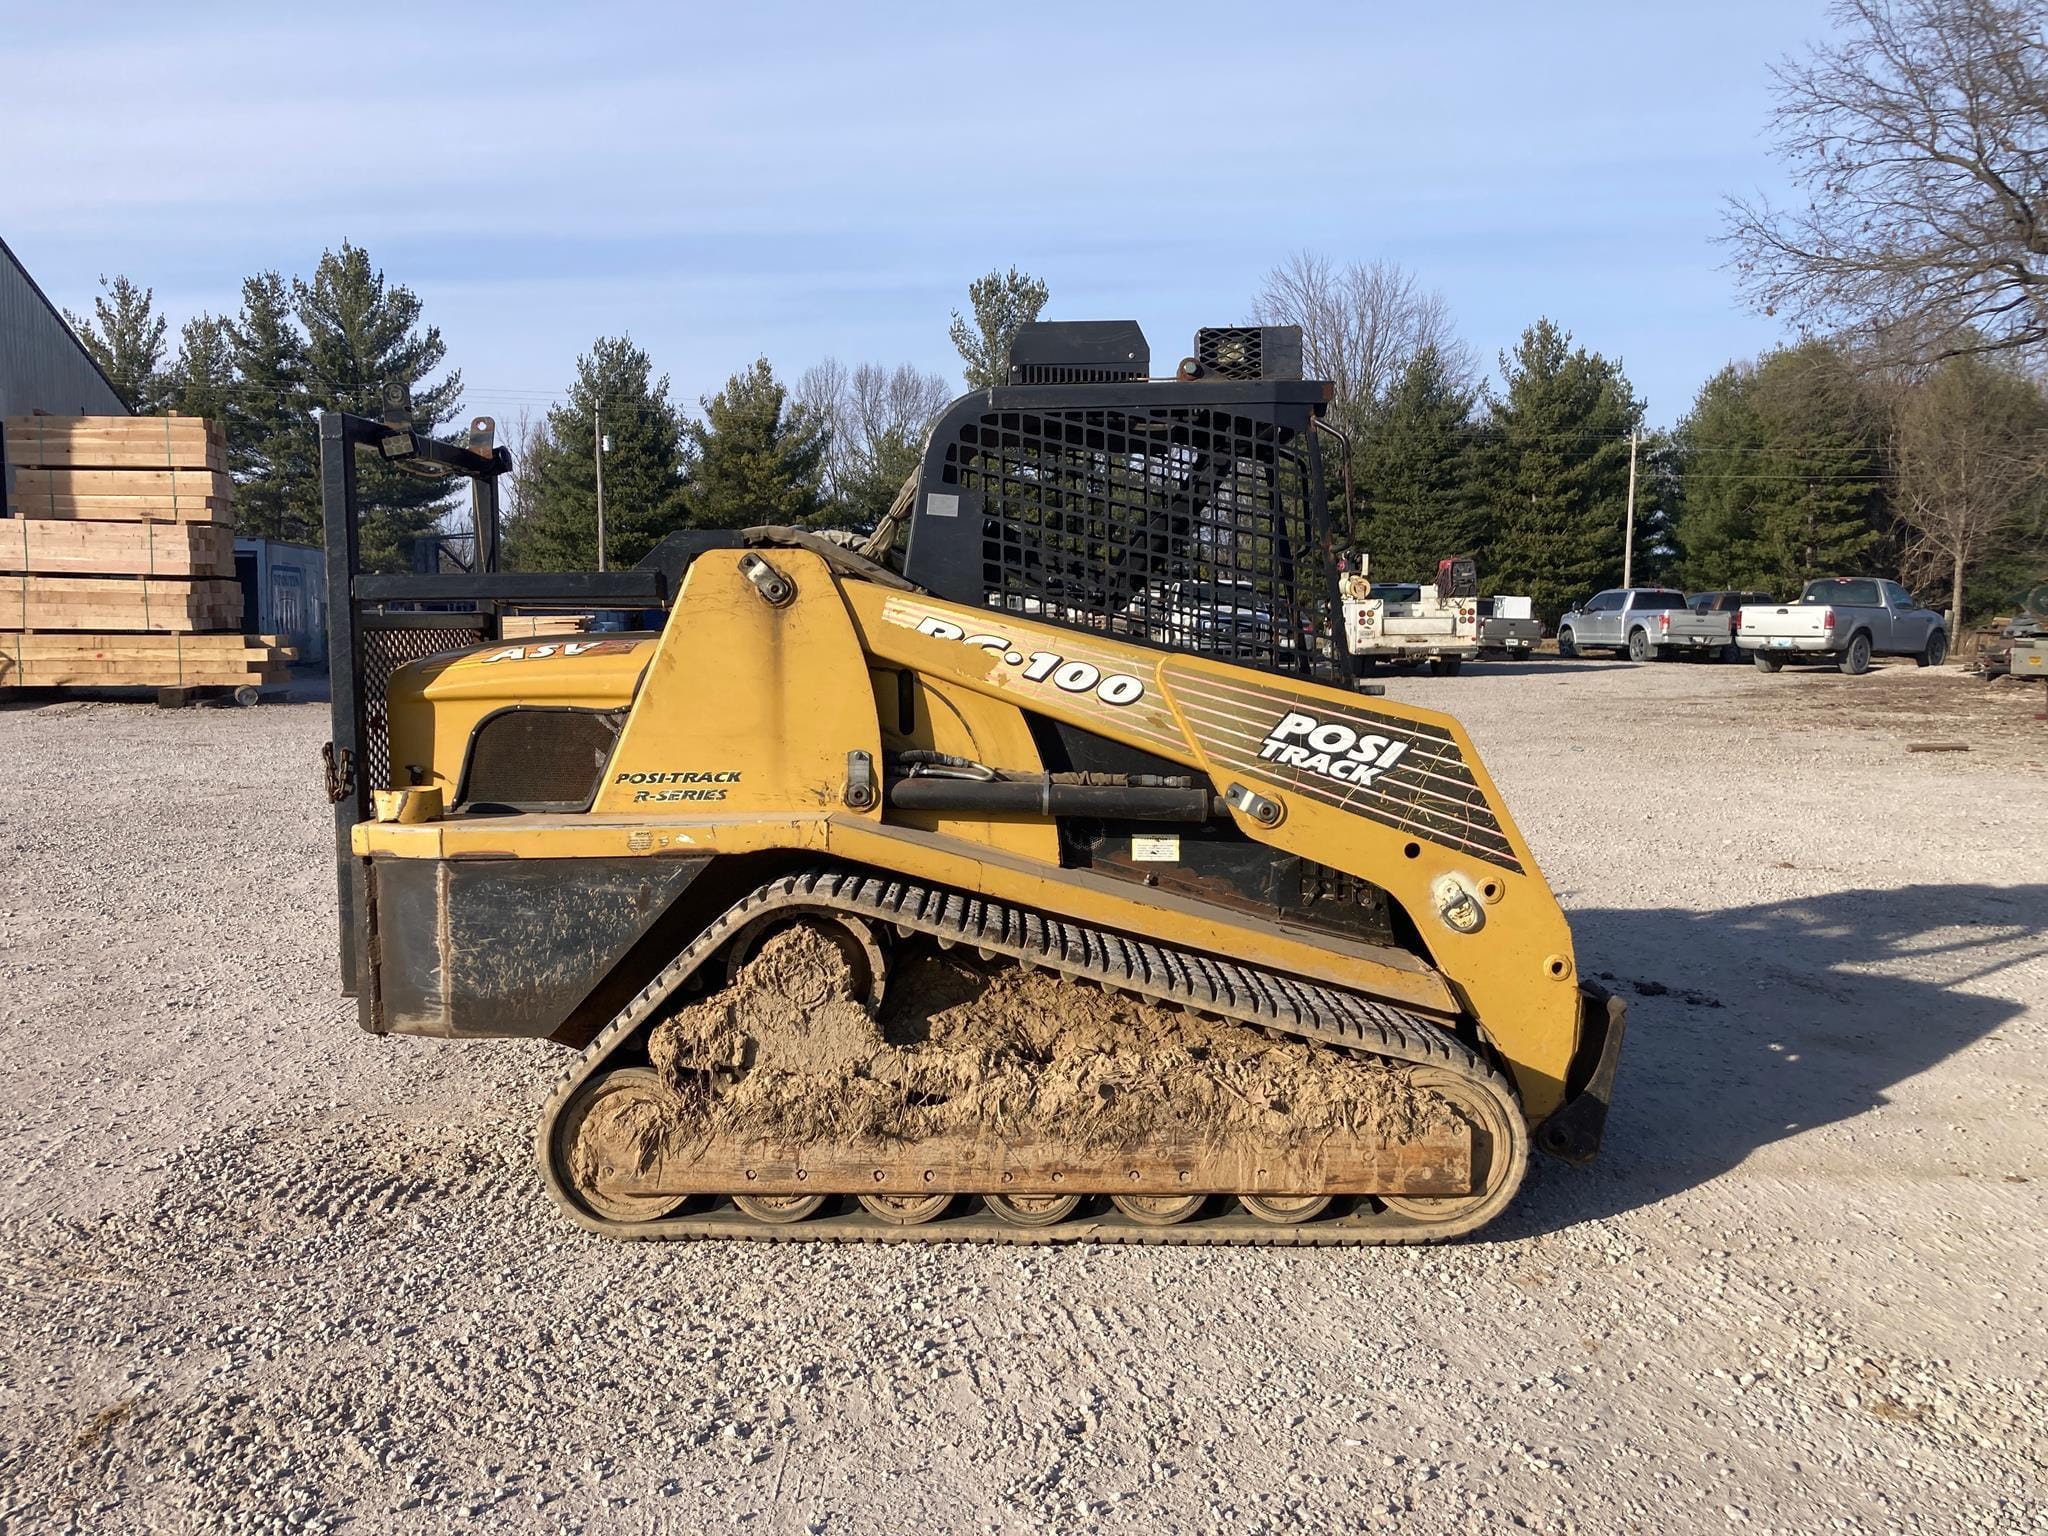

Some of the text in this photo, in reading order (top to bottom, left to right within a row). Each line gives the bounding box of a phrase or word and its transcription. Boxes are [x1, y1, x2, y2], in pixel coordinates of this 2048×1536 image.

[481, 641, 605, 664] ASV
[1270, 711, 1409, 770] POSI
[1259, 737, 1384, 787] TRACK
[614, 771, 742, 785] POSI-TRACK
[633, 788, 729, 804] R-SERIES
